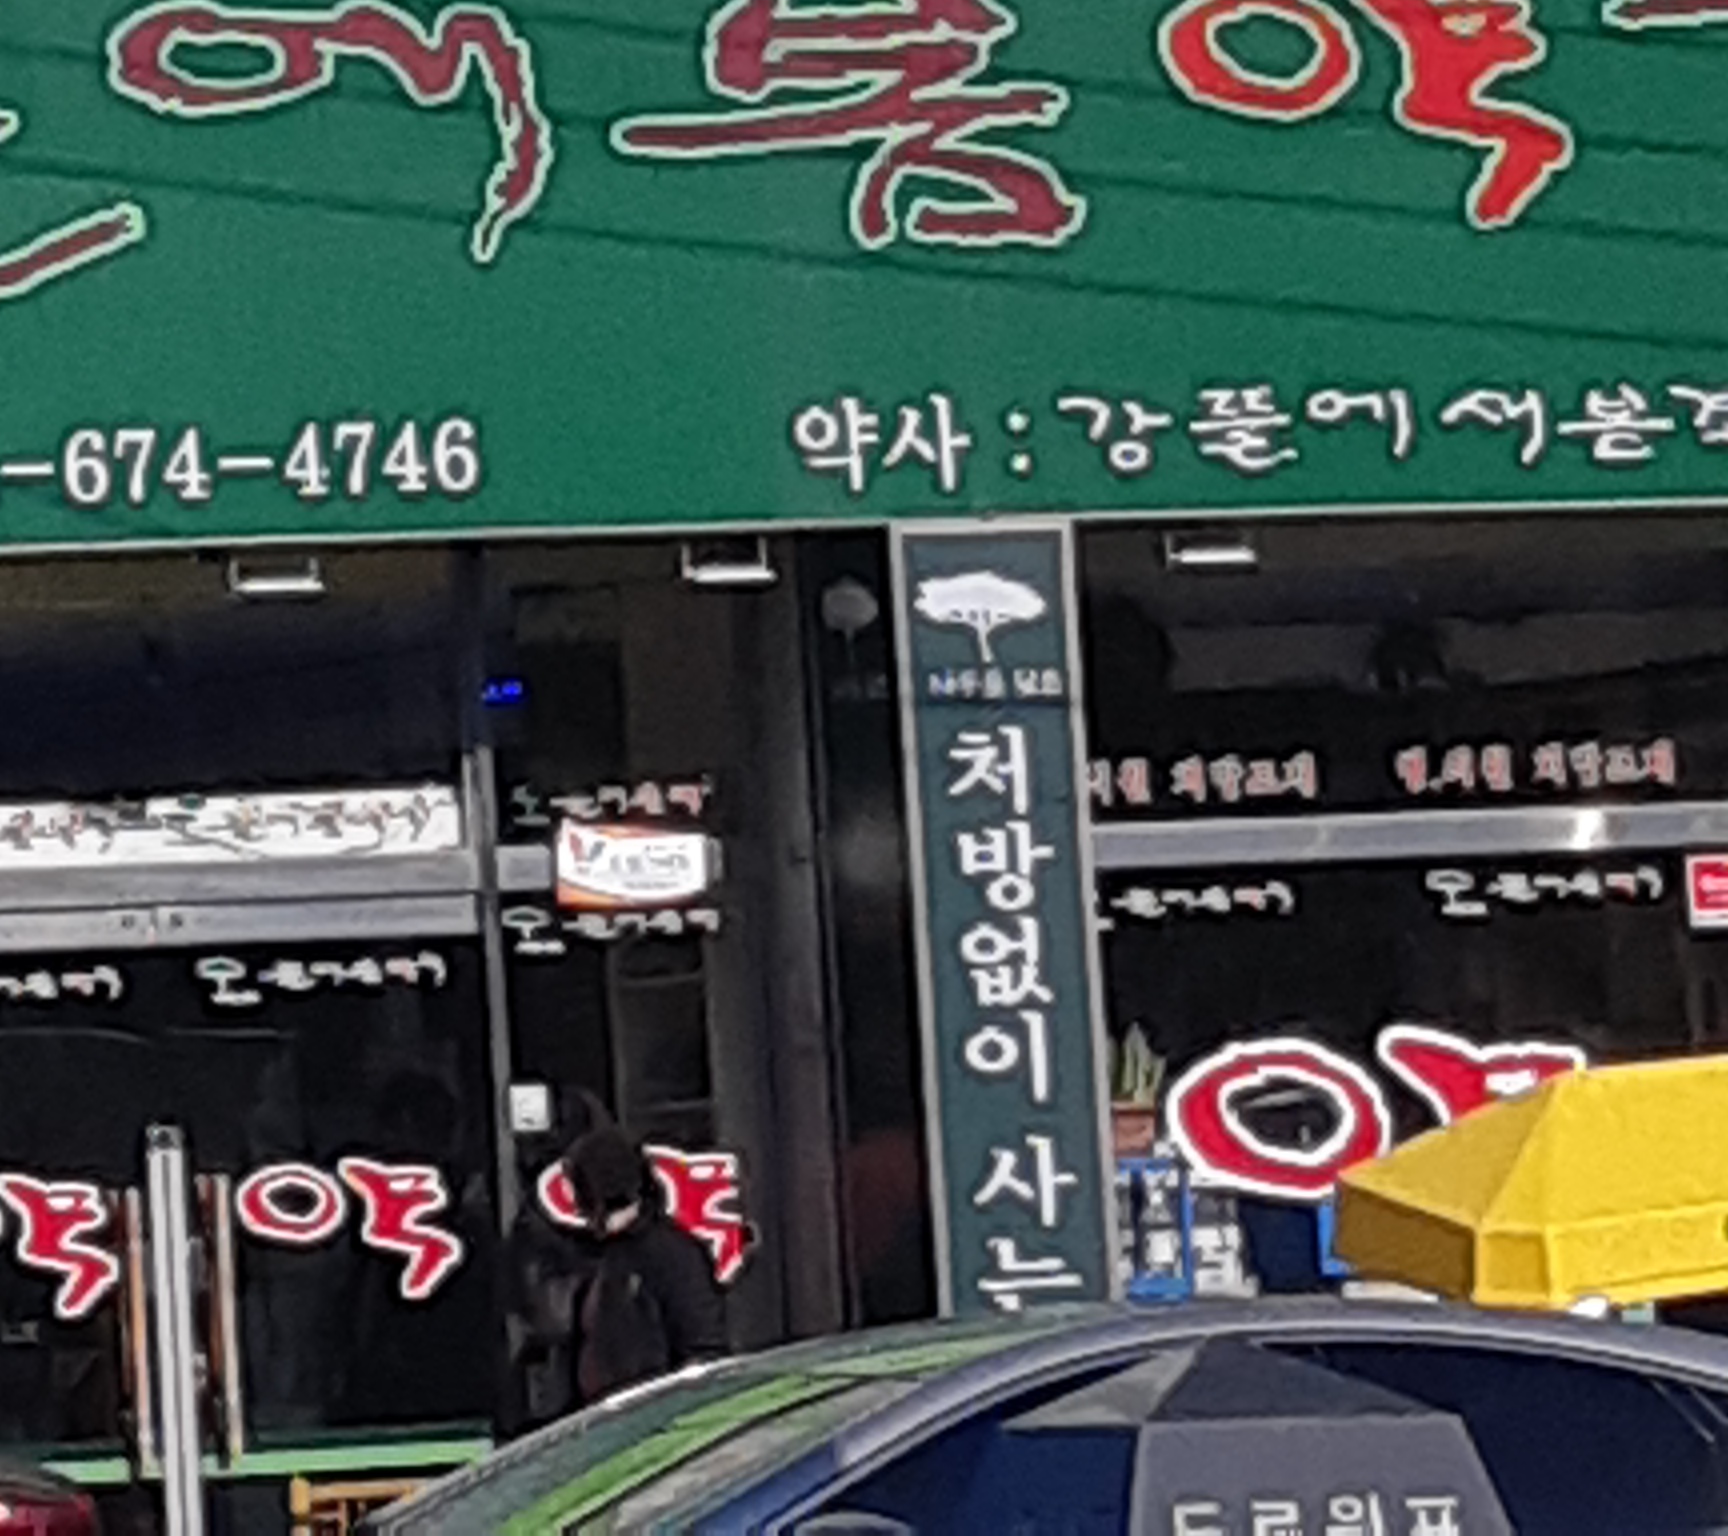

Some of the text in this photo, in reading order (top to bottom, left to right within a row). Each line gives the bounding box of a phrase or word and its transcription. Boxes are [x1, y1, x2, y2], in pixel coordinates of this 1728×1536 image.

[793, 393, 972, 491] 약사
[948, 725, 1083, 1312] 처방없이 사는
